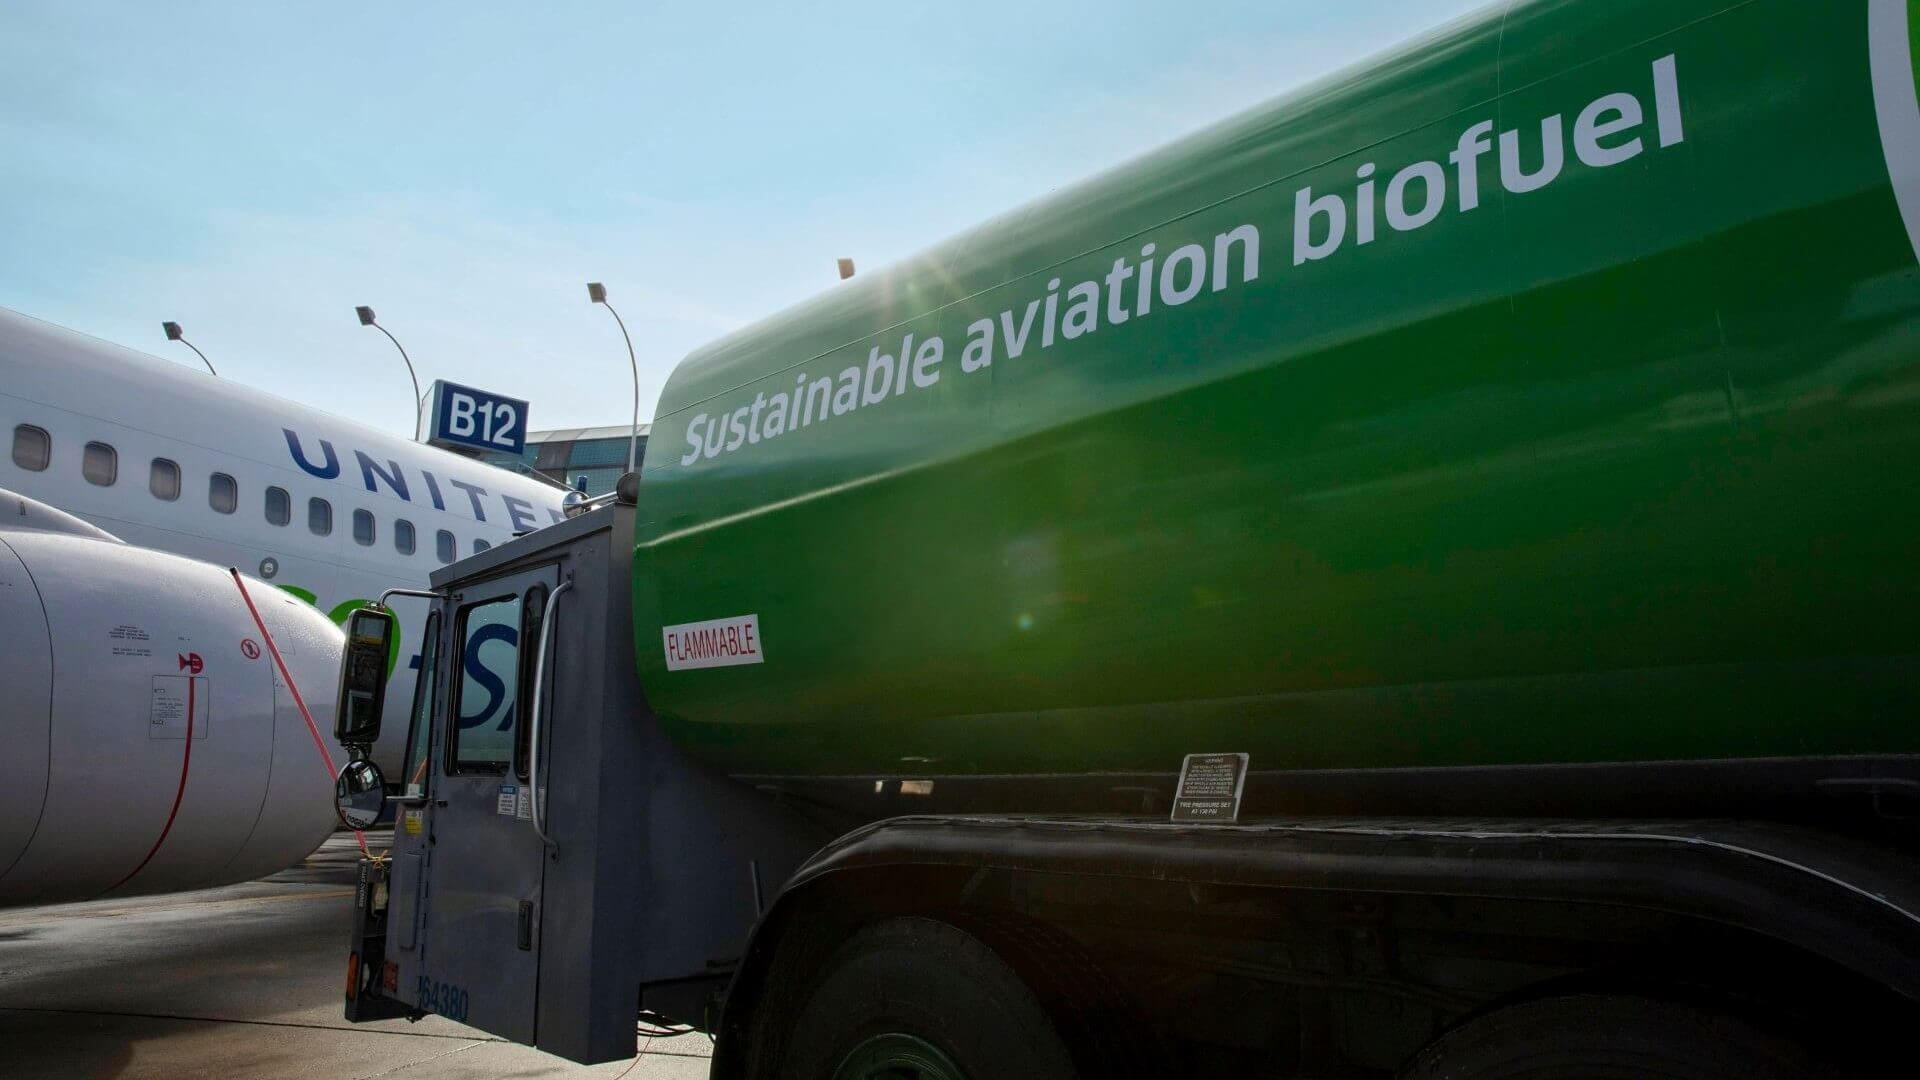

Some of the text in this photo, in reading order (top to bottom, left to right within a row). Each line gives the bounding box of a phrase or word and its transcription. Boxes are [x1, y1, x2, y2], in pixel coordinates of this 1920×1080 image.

[681, 53, 1685, 467] Sustainable aviation biofuel
[449, 391, 517, 447] B12
[668, 623, 756, 663] FLAMMABLE
